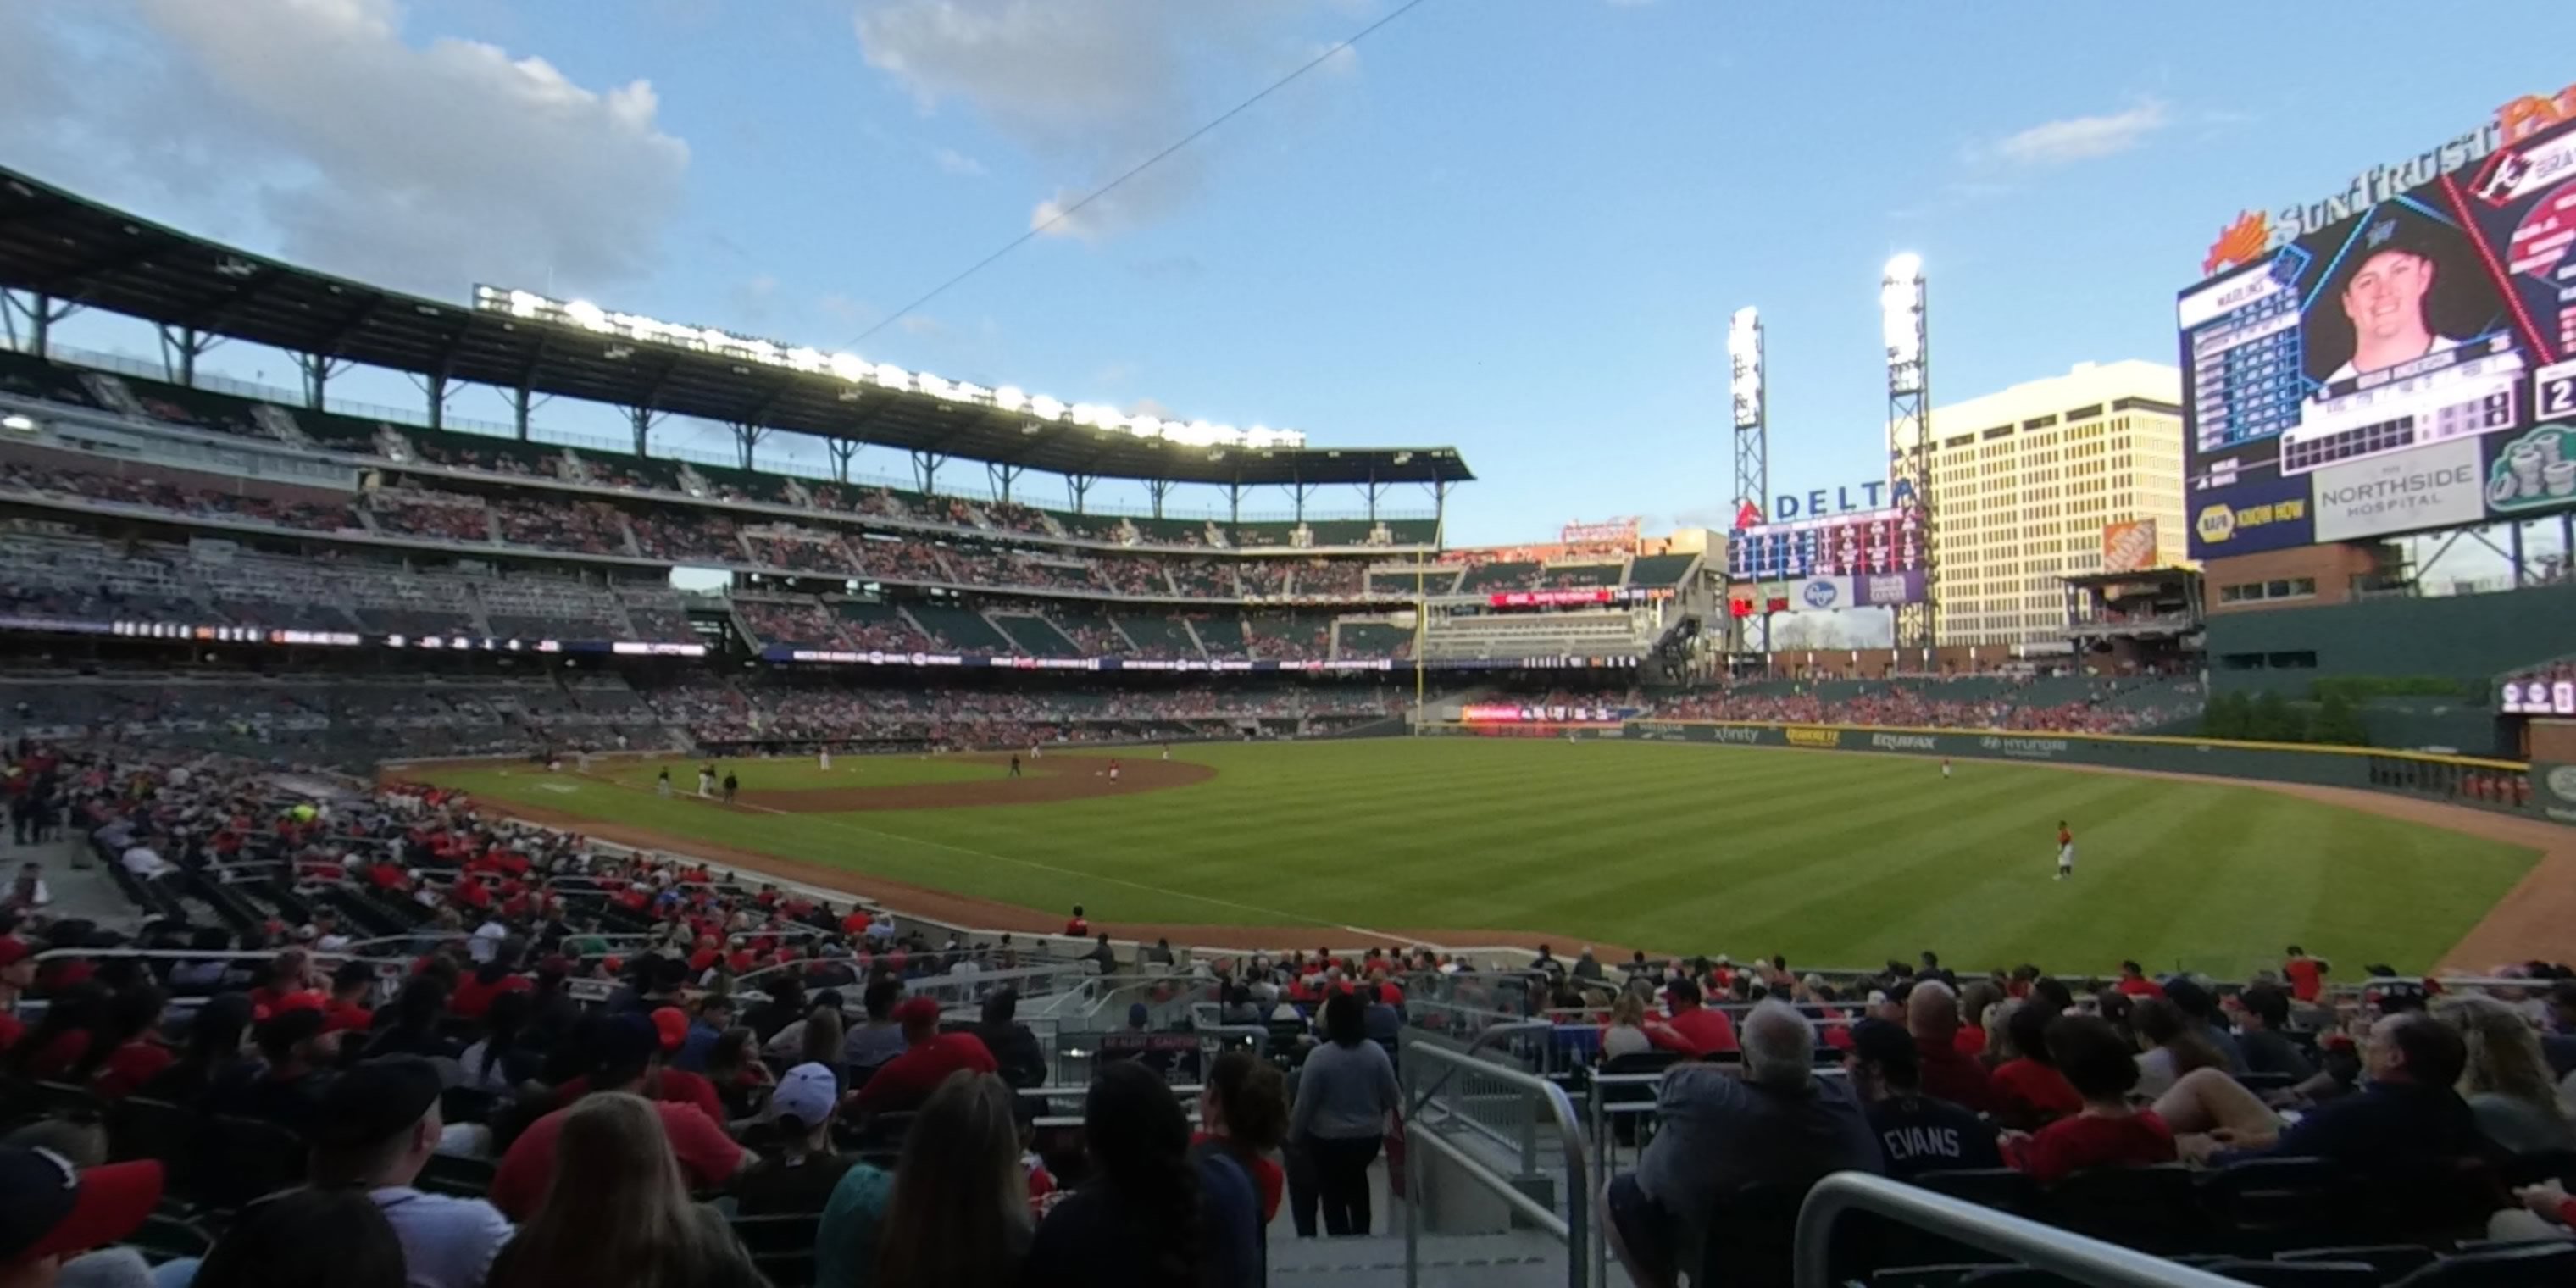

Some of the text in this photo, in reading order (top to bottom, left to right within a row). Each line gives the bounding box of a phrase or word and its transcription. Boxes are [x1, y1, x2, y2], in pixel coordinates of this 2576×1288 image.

[2322, 464, 2475, 508] NORTHSIDE
[1776, 477, 1918, 519] DELTA
[2346, 493, 2442, 518] HOSPITAL
[2204, 514, 2229, 531] NAPA
[1714, 726, 1759, 743] xfinity
[1871, 733, 1937, 750] EQUIFAX
[2003, 738, 2068, 752] HYUNDAI
[1883, 1126, 1961, 1161] EVANS
